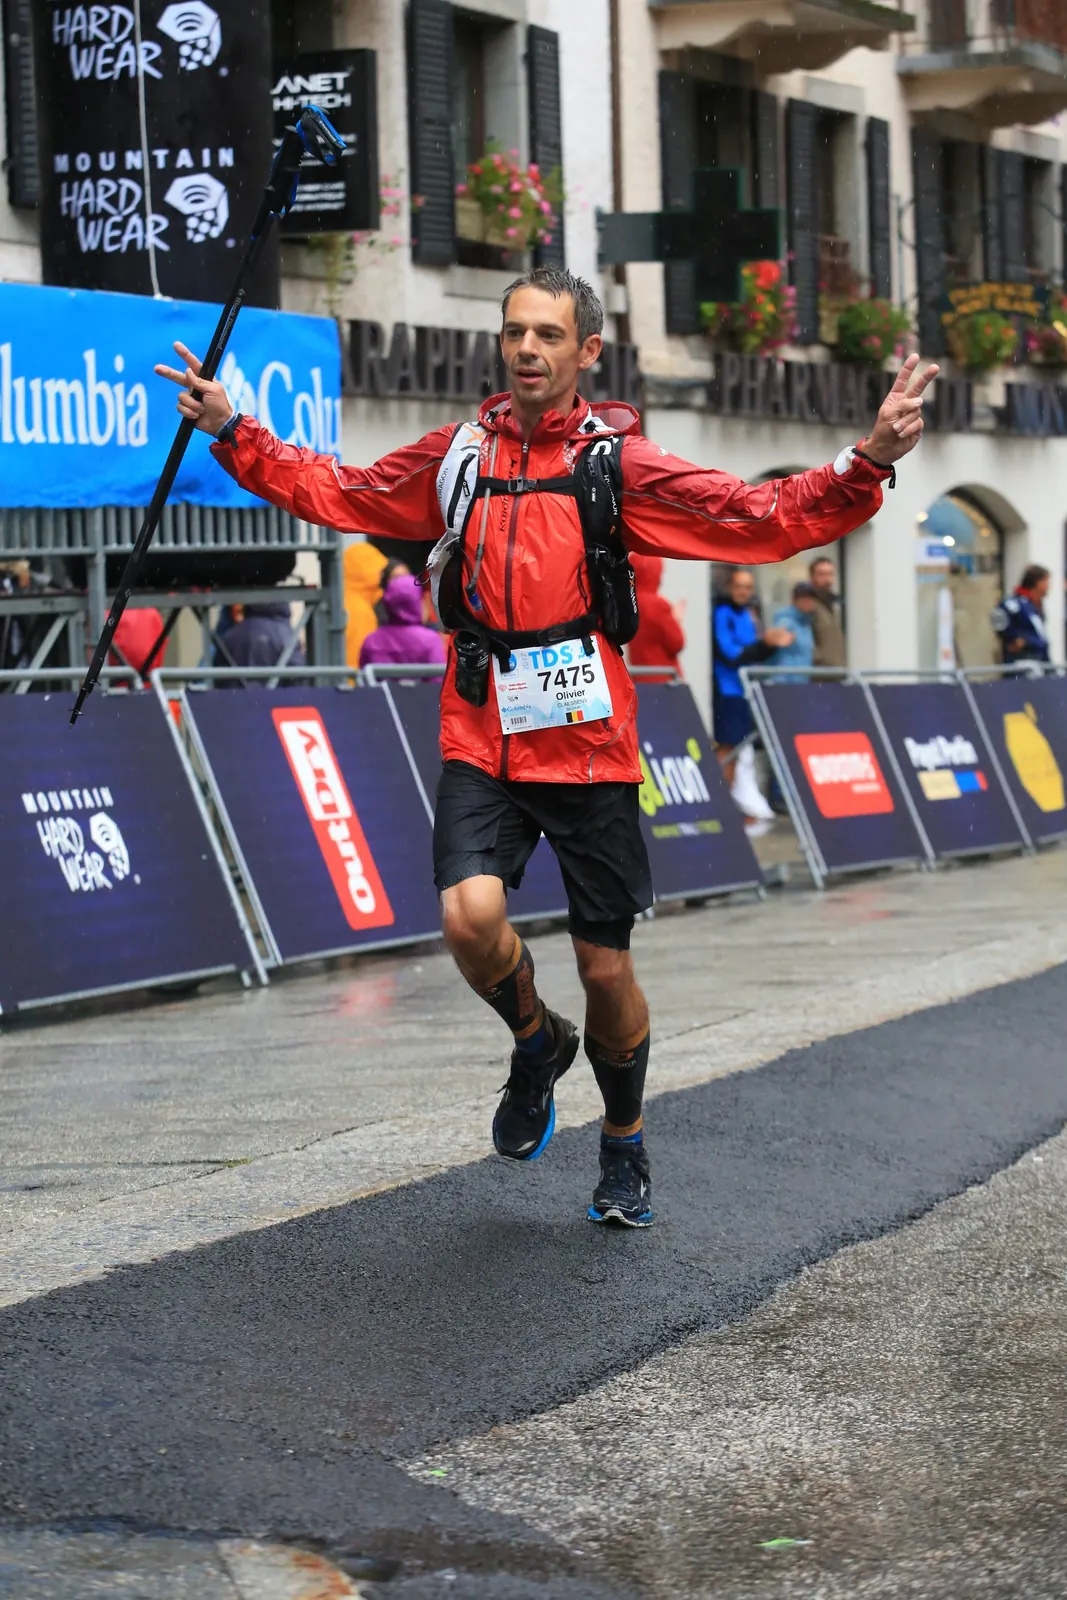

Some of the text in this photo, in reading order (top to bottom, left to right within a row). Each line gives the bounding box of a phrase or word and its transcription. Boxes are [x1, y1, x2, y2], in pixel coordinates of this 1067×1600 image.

[52, 4, 135, 44] HARD
[69, 42, 164, 81] WEAR
[269, 71, 351, 96] ANET
[53, 147, 235, 174] MOUNTAIN
[60, 178, 143, 219] HARD
[76, 213, 170, 254] WEAR
[0, 341, 149, 447] lumbia
[258, 360, 342, 456] Colu
[528, 645, 574, 670] TDS
[537, 663, 596, 692] 7475
[556, 689, 586, 701] Olivier
[21, 786, 114, 814] MOUNTAIN
[36, 814, 86, 858] HARD
[296, 726, 377, 915] OutDry
[59, 851, 114, 893] WEAR
